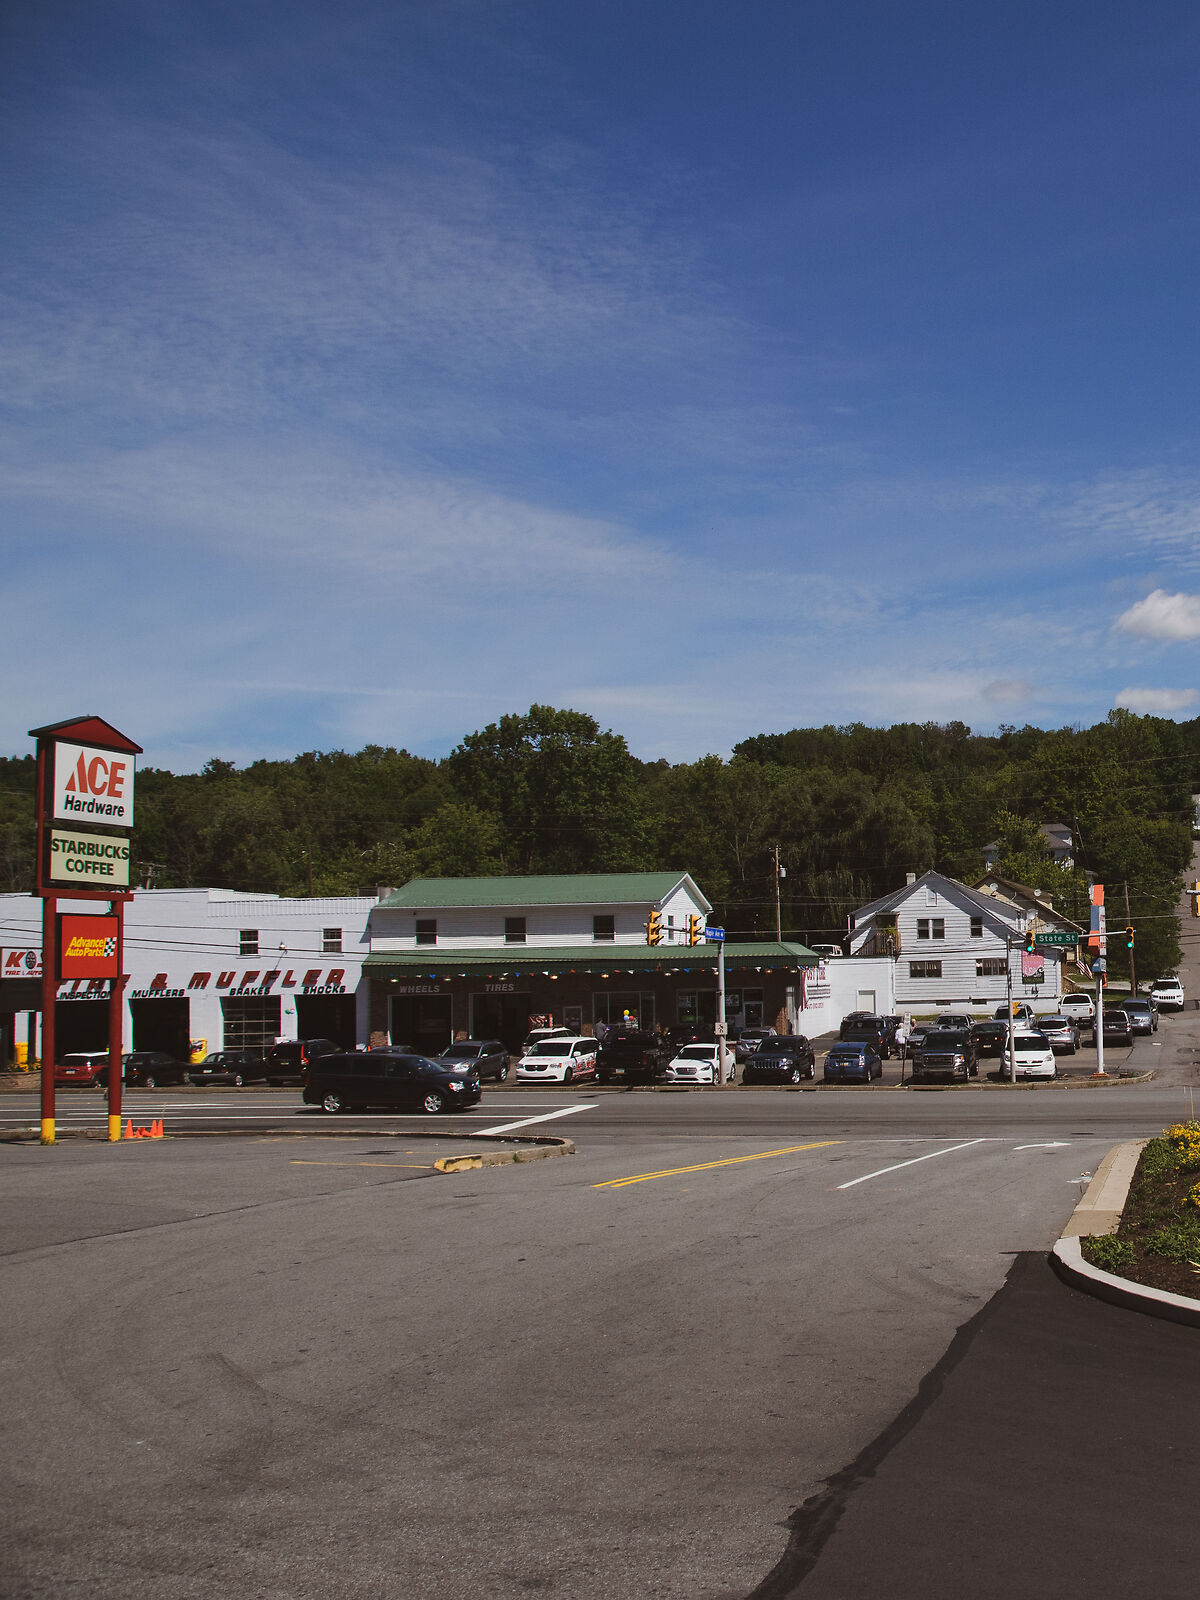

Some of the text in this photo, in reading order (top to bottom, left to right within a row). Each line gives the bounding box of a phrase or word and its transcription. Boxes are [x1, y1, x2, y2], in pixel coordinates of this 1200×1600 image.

[64, 749, 127, 798] ACE
[63, 794, 125, 818] Hardware
[51, 838, 130, 860] STARBUCKS
[65, 858, 114, 876] COFFEE
[70, 936, 104, 948] Advance
[65, 947, 104, 957] Auto Parts
[149, 972, 167, 990] &
[187, 969, 345, 989] MUFFLER
[132, 988, 185, 998] MUFFLERS
[229, 986, 271, 996] BRAKES
[303, 985, 346, 994] SHOCKS
[400, 985, 440, 993] WHEELS
[485, 983, 515, 992] TIRES
